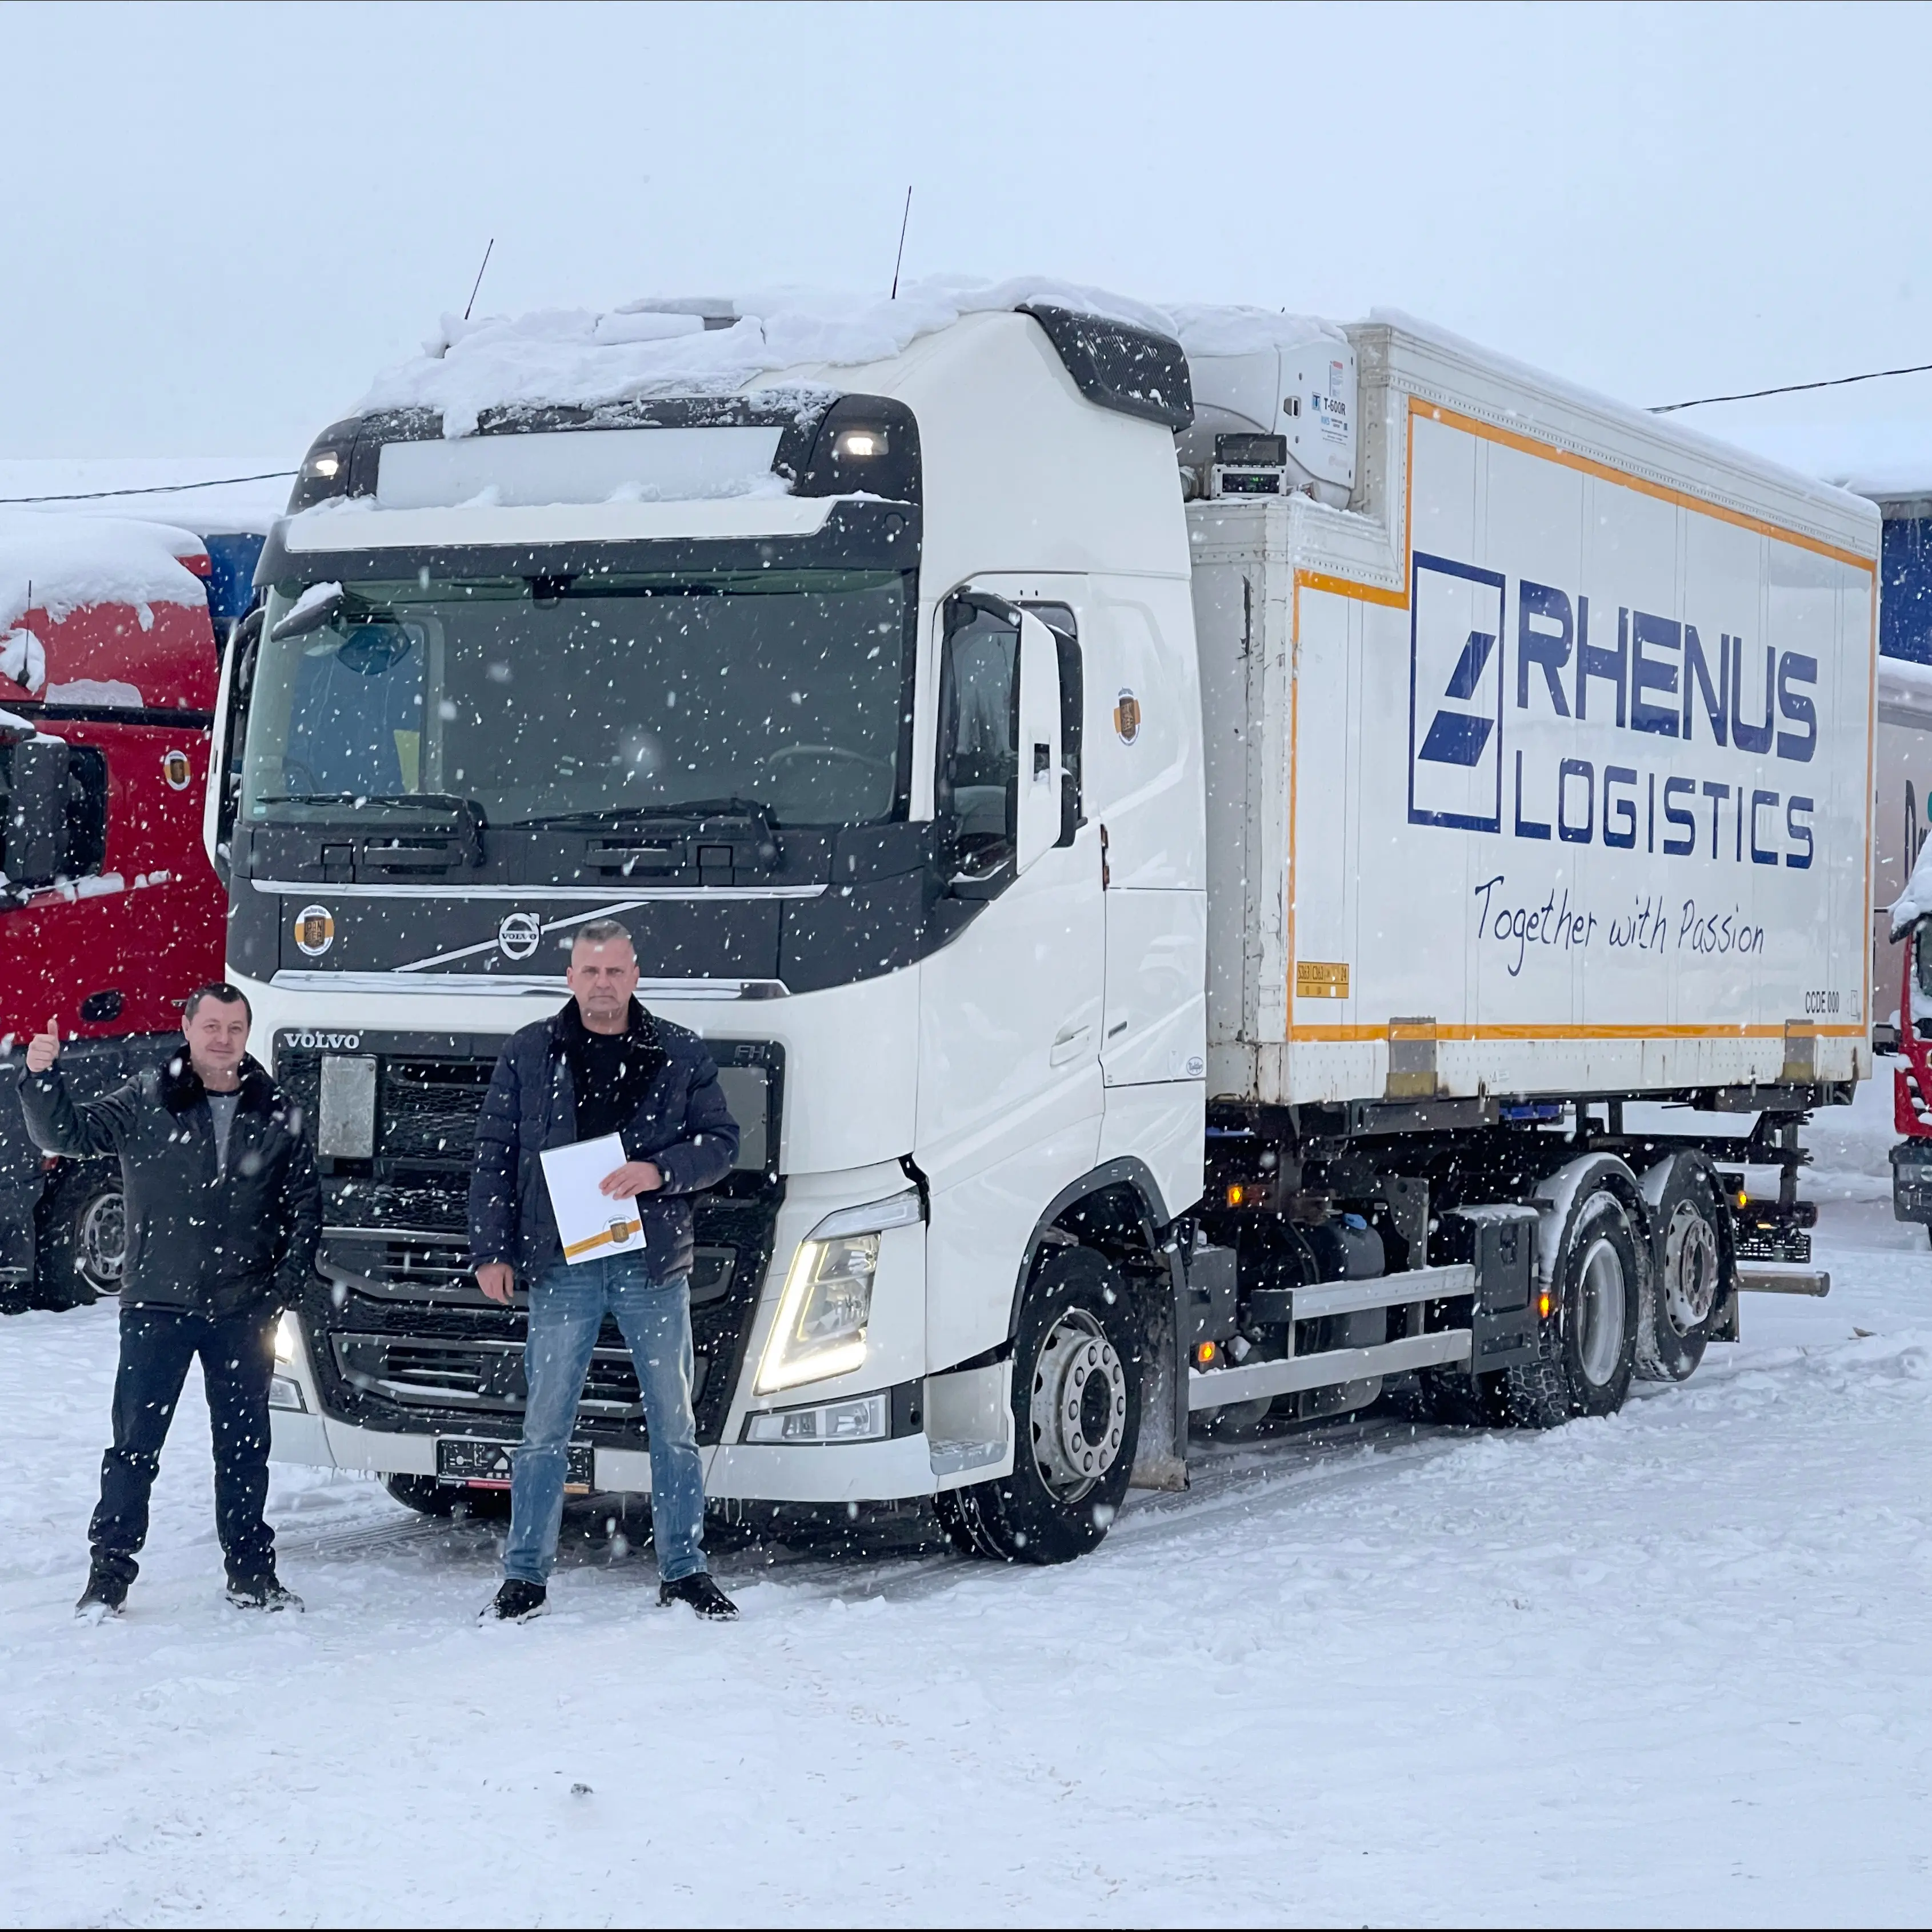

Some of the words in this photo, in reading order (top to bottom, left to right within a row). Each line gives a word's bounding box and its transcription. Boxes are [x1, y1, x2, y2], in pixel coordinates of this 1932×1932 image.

[1324, 397, 1346, 415] T-600R
[1517, 579, 1818, 763] RHENUS
[1515, 750, 1814, 869] LOGISTICS
[1475, 875, 1597, 977] Together
[1609, 894, 1667, 954] with
[1678, 899, 1764, 954] Passion
[283, 1033, 359, 1049] VOLVO
[734, 1045, 766, 1059] FH
